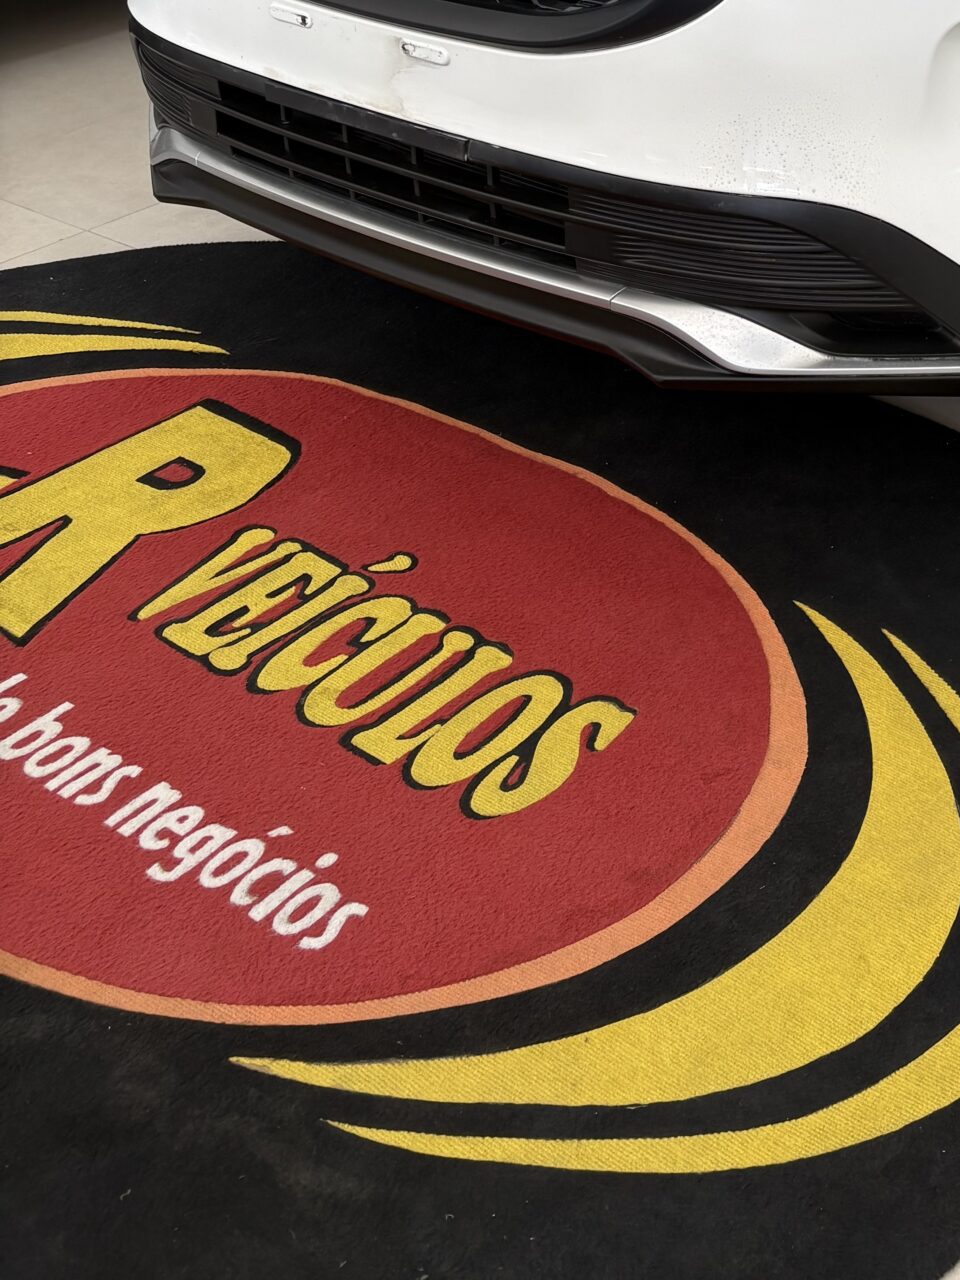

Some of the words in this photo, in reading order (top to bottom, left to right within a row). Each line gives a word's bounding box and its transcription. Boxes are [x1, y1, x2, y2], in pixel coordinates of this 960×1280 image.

[0, 398, 302, 647] R
[0, 701, 144, 805] bons
[103, 780, 370, 950] negócios
